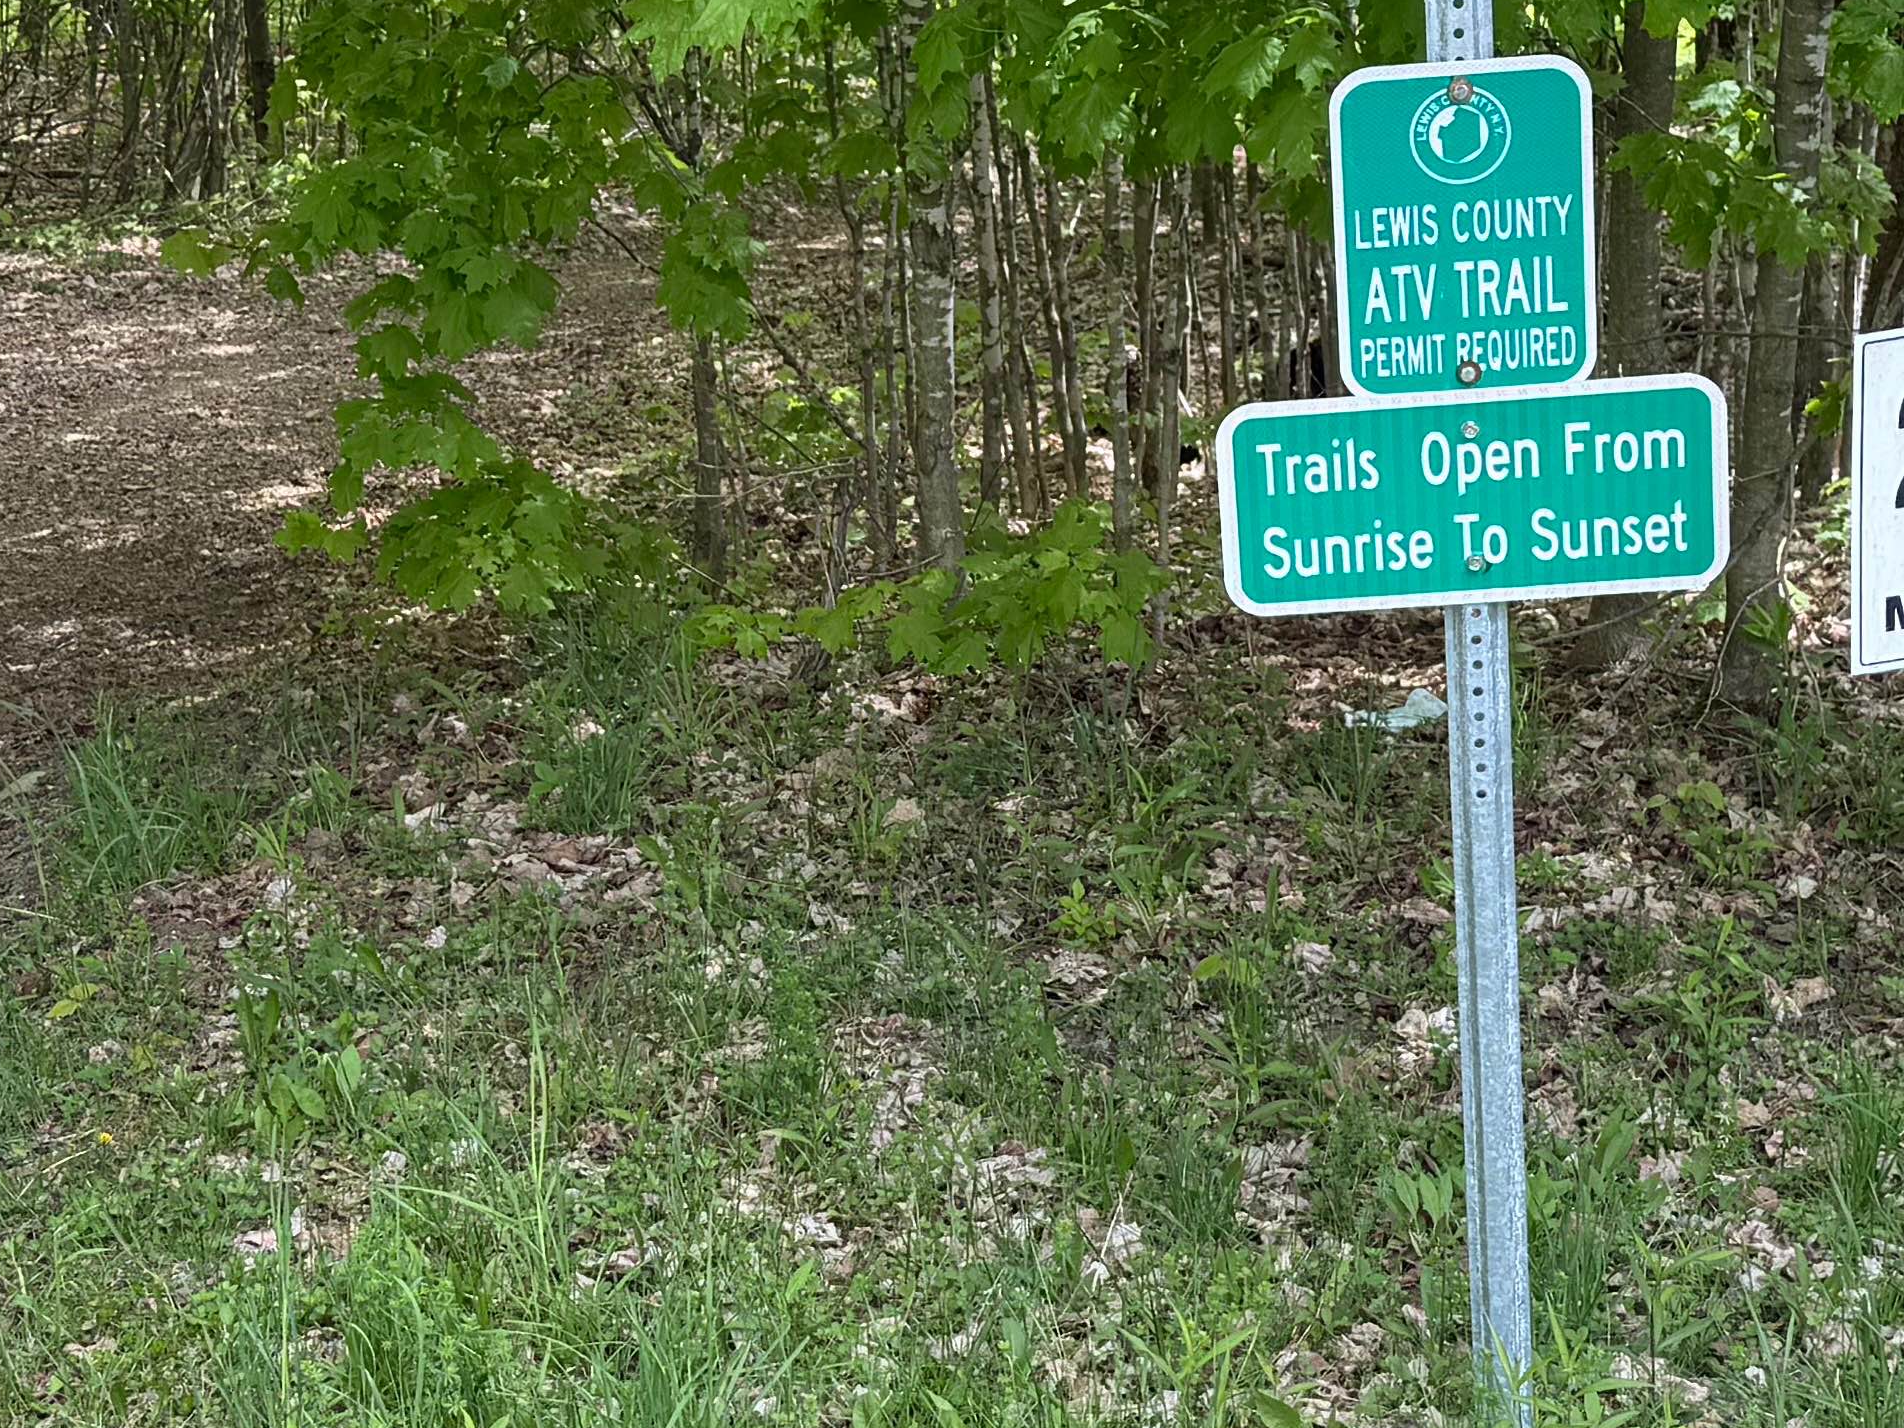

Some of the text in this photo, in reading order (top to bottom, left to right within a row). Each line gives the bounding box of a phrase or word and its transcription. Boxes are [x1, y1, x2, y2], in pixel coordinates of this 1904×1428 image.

[1416, 102, 1440, 141] LEWIS
[1440, 91, 1494, 113] CNTY
[1354, 194, 1573, 250] LEWIS COUNTY
[1364, 255, 1569, 324] ATV TRAIL
[1360, 325, 1577, 378] PERMIT REQUIRED
[1255, 422, 1686, 496] Trails Open From
[1263, 499, 1688, 579] Sunrise To Sunset
